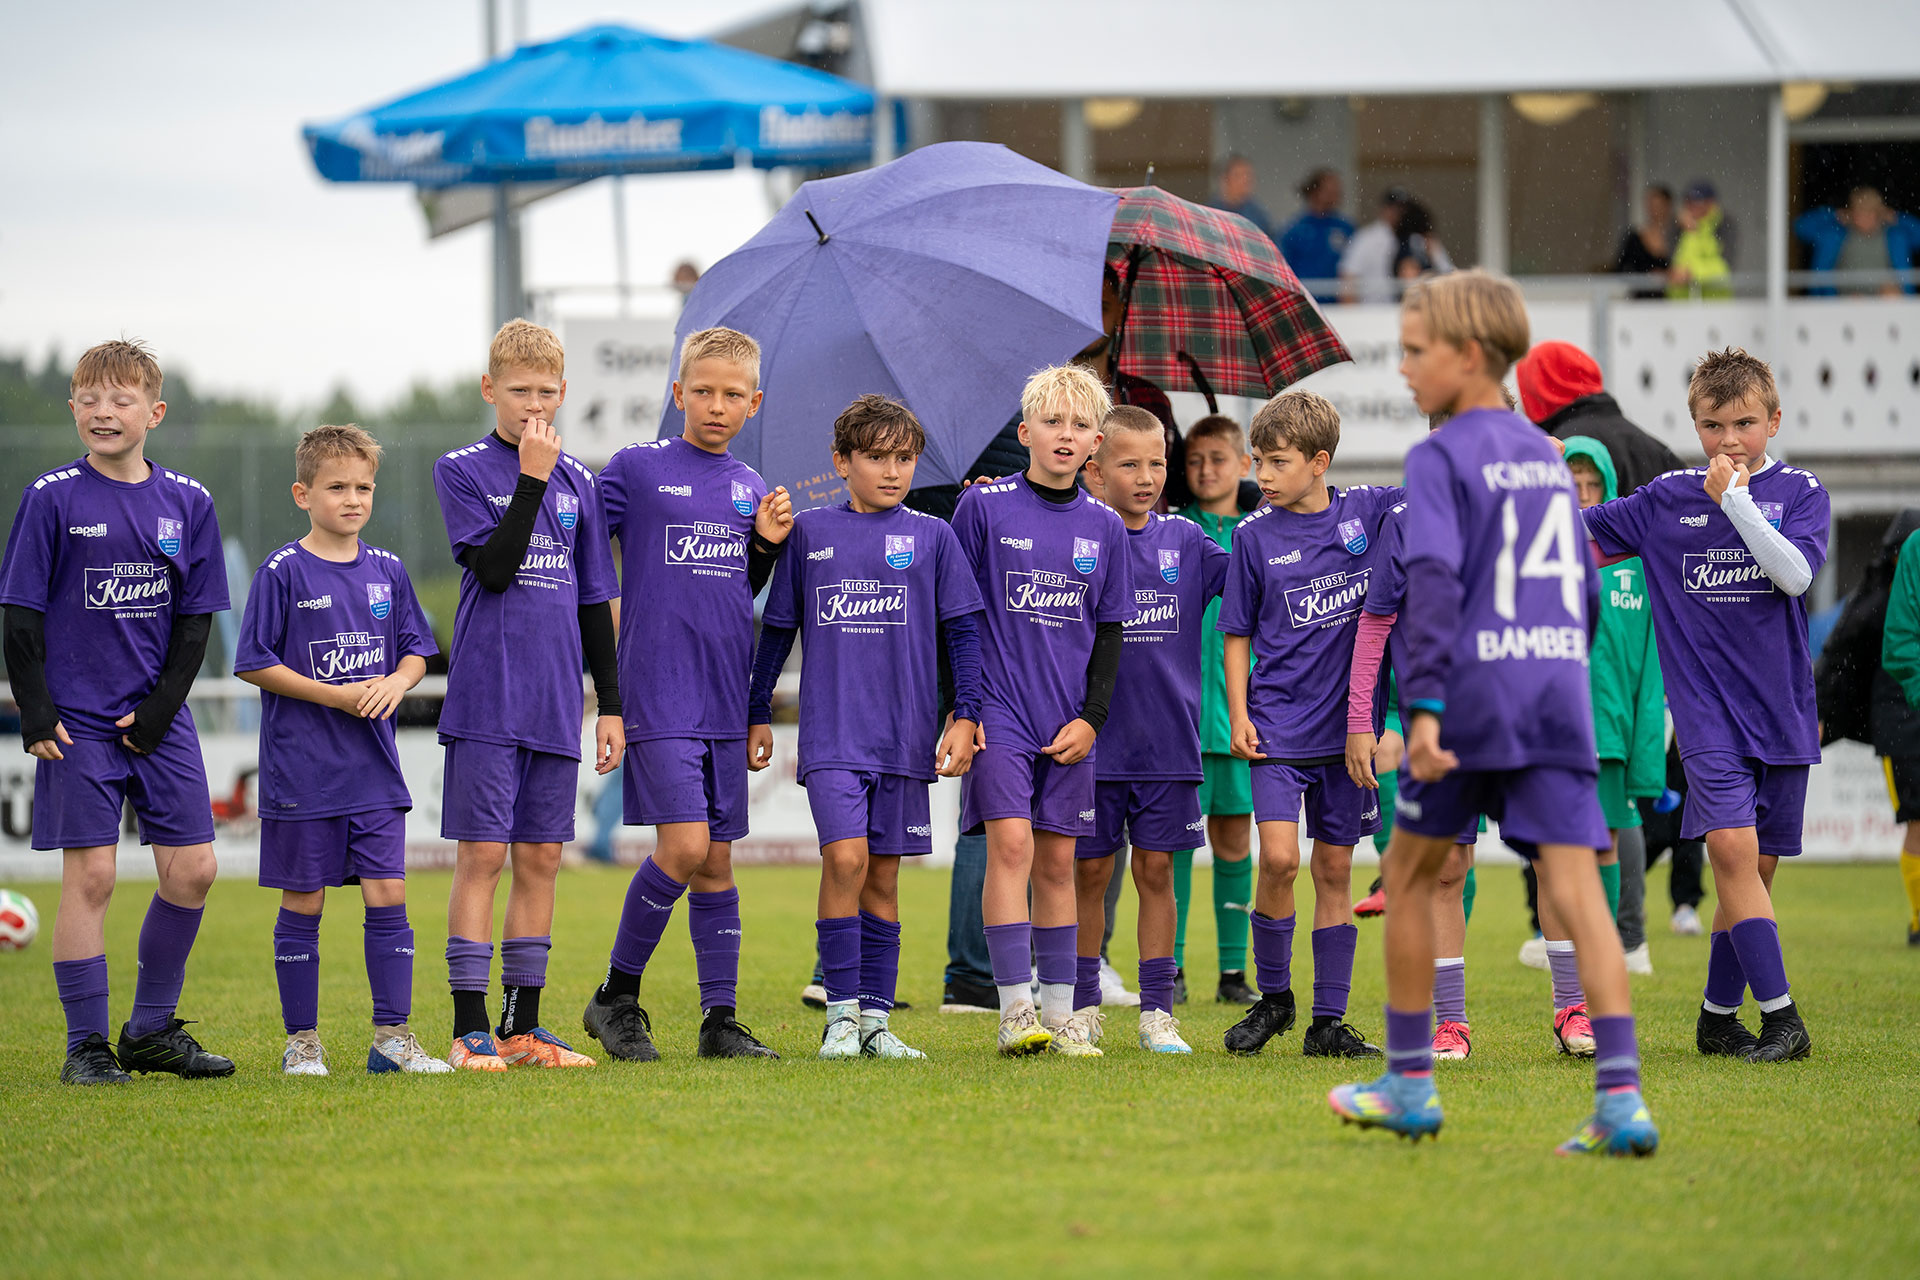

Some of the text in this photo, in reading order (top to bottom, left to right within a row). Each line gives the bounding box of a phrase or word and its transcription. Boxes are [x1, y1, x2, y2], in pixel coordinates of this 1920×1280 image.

[658, 485, 692, 496] capelli
[1680, 514, 1708, 526] capelli
[69, 523, 107, 536] capelli
[697, 524, 727, 536] KIOSK
[530, 536, 551, 547] IOSK
[669, 536, 744, 561] Kunni
[1000, 536, 1032, 550] capelli
[519, 549, 568, 570] unni
[1268, 549, 1301, 565] capelli
[1495, 492, 1585, 622] 14
[1709, 551, 1741, 560] KIOSK
[116, 565, 150, 575] KIOSK
[692, 568, 732, 578] WUNDERBURG
[1033, 572, 1063, 585] KIOSK
[1314, 575, 1344, 590] KIOSK
[89, 569, 168, 606] Kunni
[844, 581, 876, 592] KIOSK
[297, 595, 332, 609] capelli
[1009, 583, 1083, 609] Kunni
[1294, 573, 1369, 622] Kunni
[1611, 590, 1643, 611] BGW
[820, 588, 904, 622] Kunni
[841, 626, 885, 634] WUNDERBURG
[339, 634, 368, 645] KIOSK
[1476, 625, 1590, 667] BAMBER
[316, 639, 384, 678] Kunni
